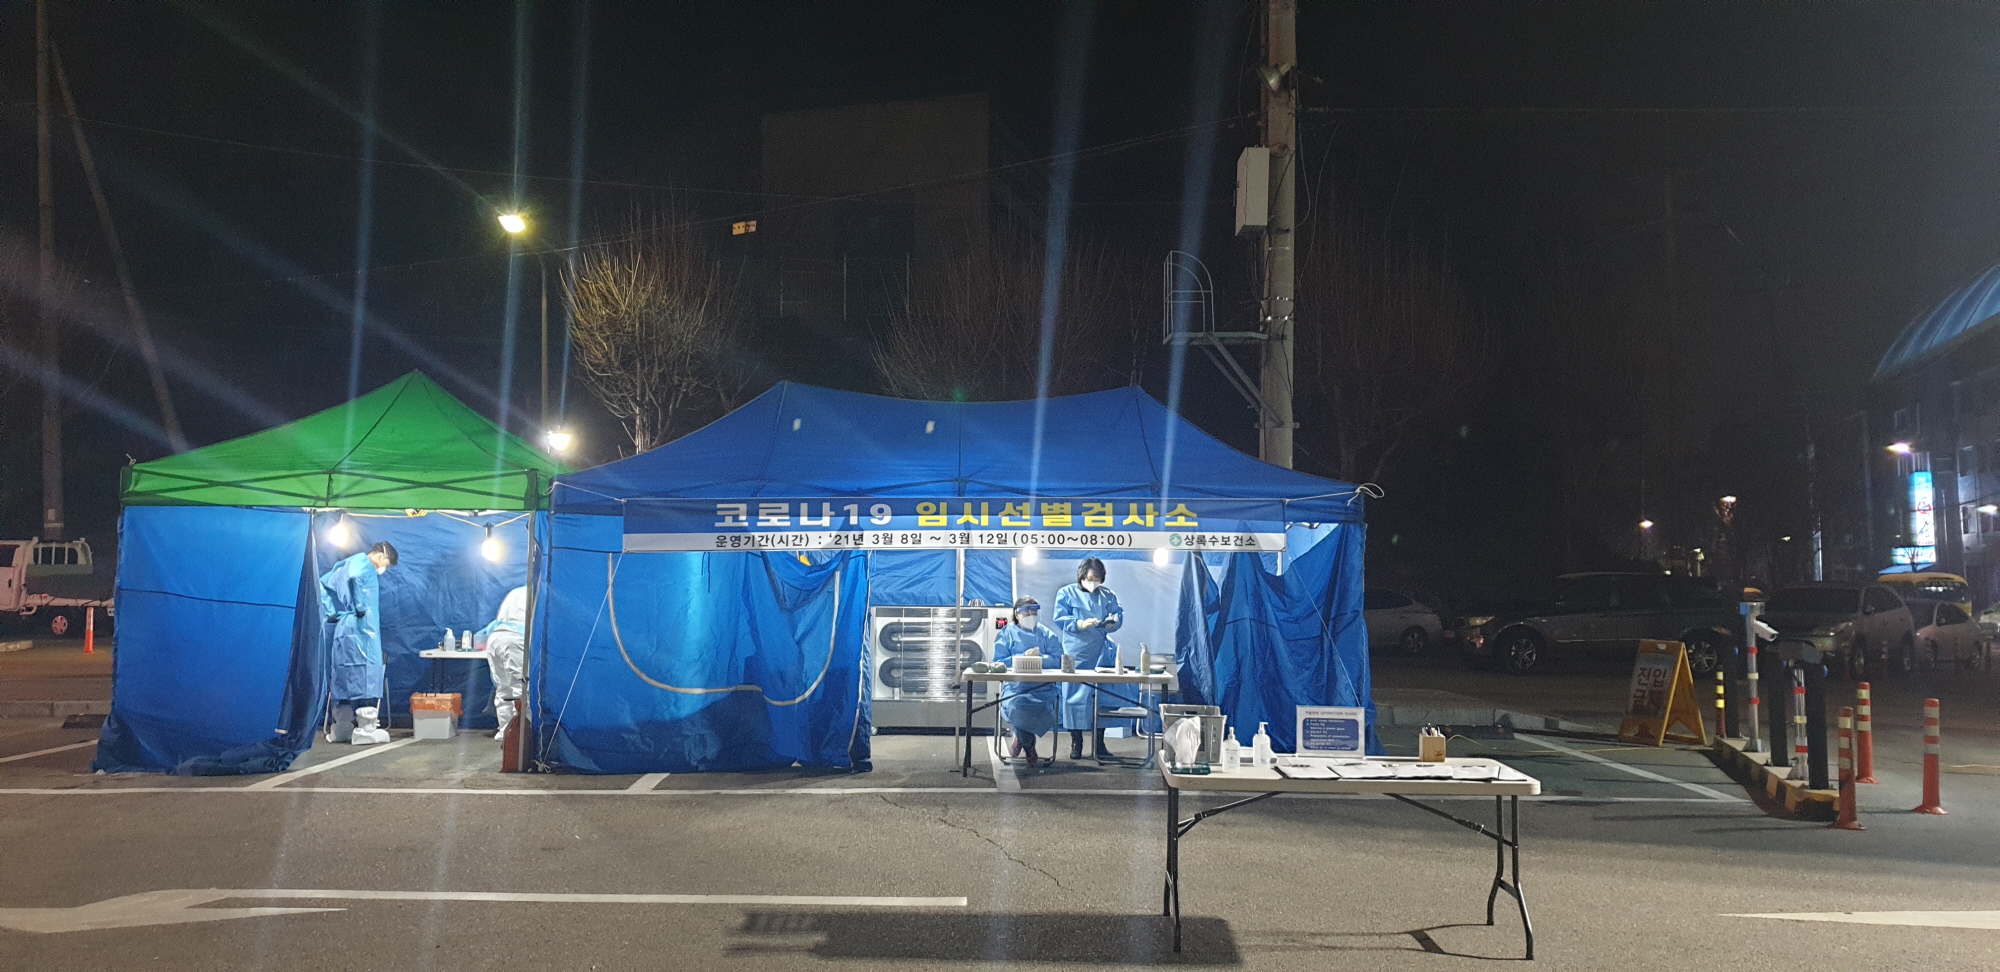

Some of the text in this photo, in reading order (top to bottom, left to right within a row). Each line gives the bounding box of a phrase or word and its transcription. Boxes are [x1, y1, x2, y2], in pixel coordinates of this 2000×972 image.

[714, 502, 1199, 527] 코로나19 임시선별검사소
[715, 534, 809, 547] 운영기간(시간)
[872, 532, 893, 545] 3월
[900, 532, 922, 545] 8일
[949, 532, 970, 545] 3월
[1184, 534, 1256, 547] 상록수보건소
[1637, 667, 1667, 687] 진입
